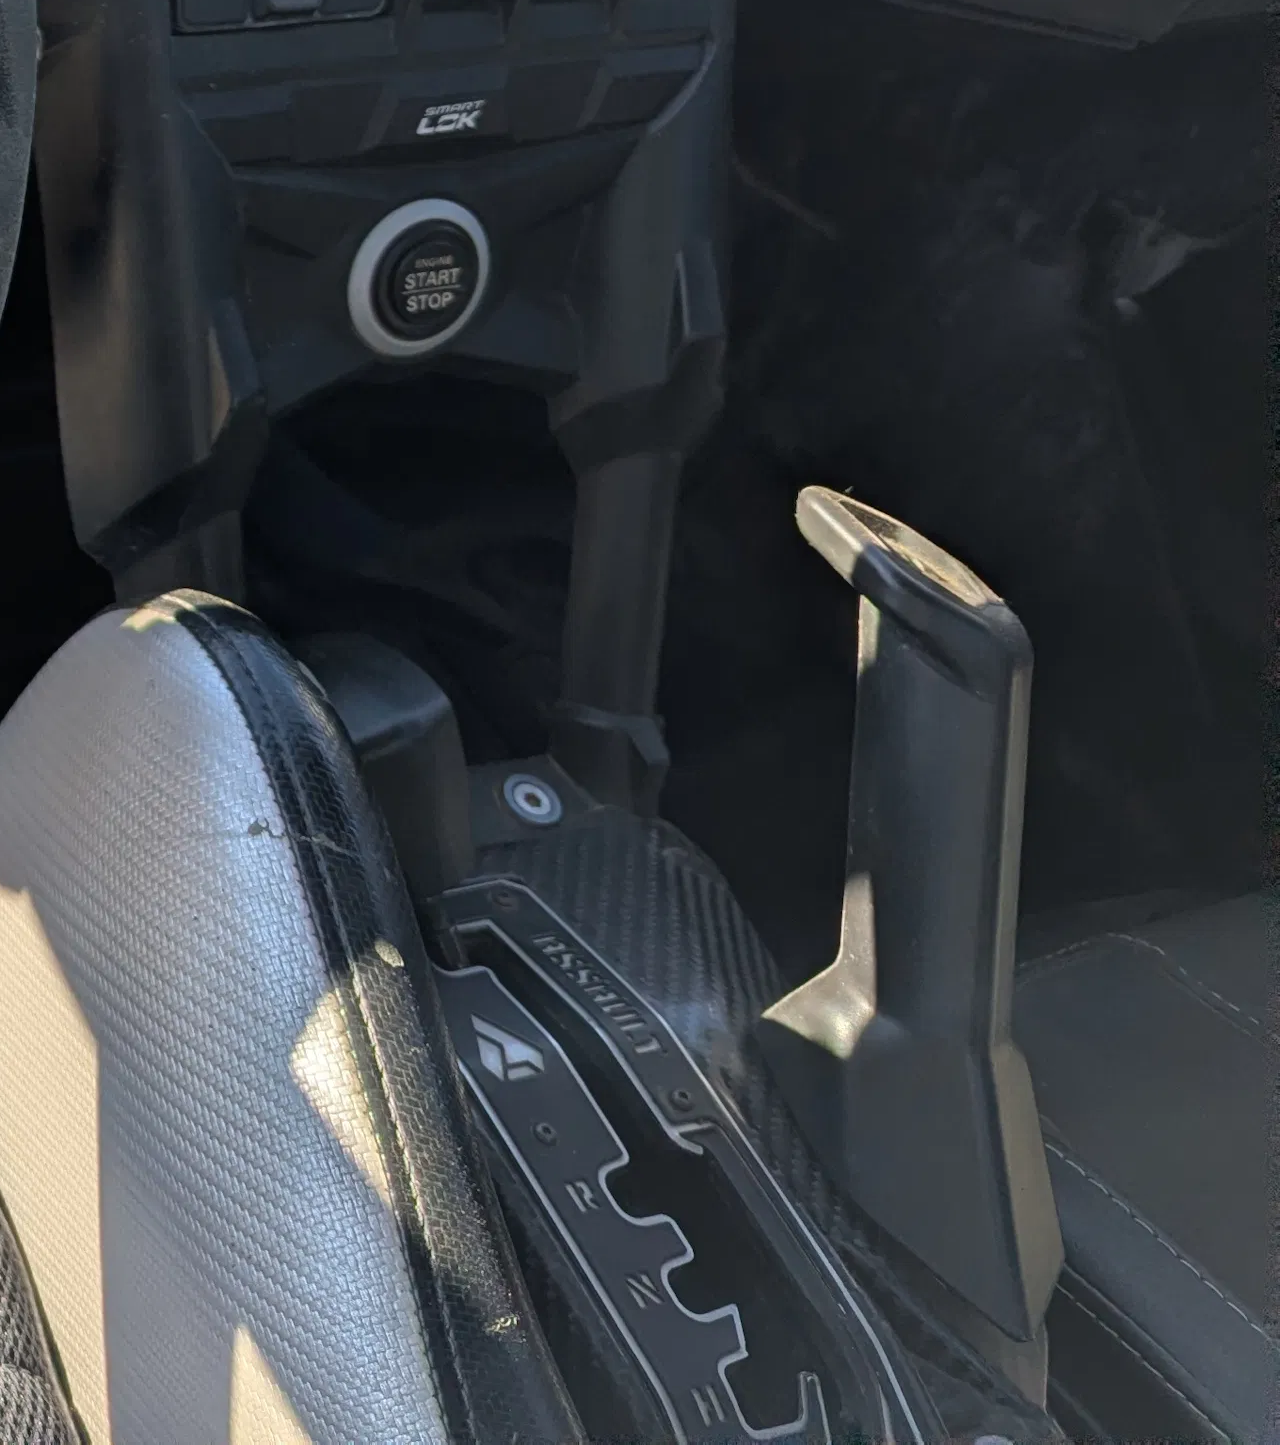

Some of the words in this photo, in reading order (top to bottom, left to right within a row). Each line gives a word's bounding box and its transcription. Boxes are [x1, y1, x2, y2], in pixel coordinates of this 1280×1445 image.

[423, 99, 487, 117] SMART
[404, 267, 463, 291] START
[405, 291, 455, 314] STOP
[531, 931, 669, 1057] ASSAULT
[625, 1273, 665, 1310] N
[689, 1383, 726, 1428] H
